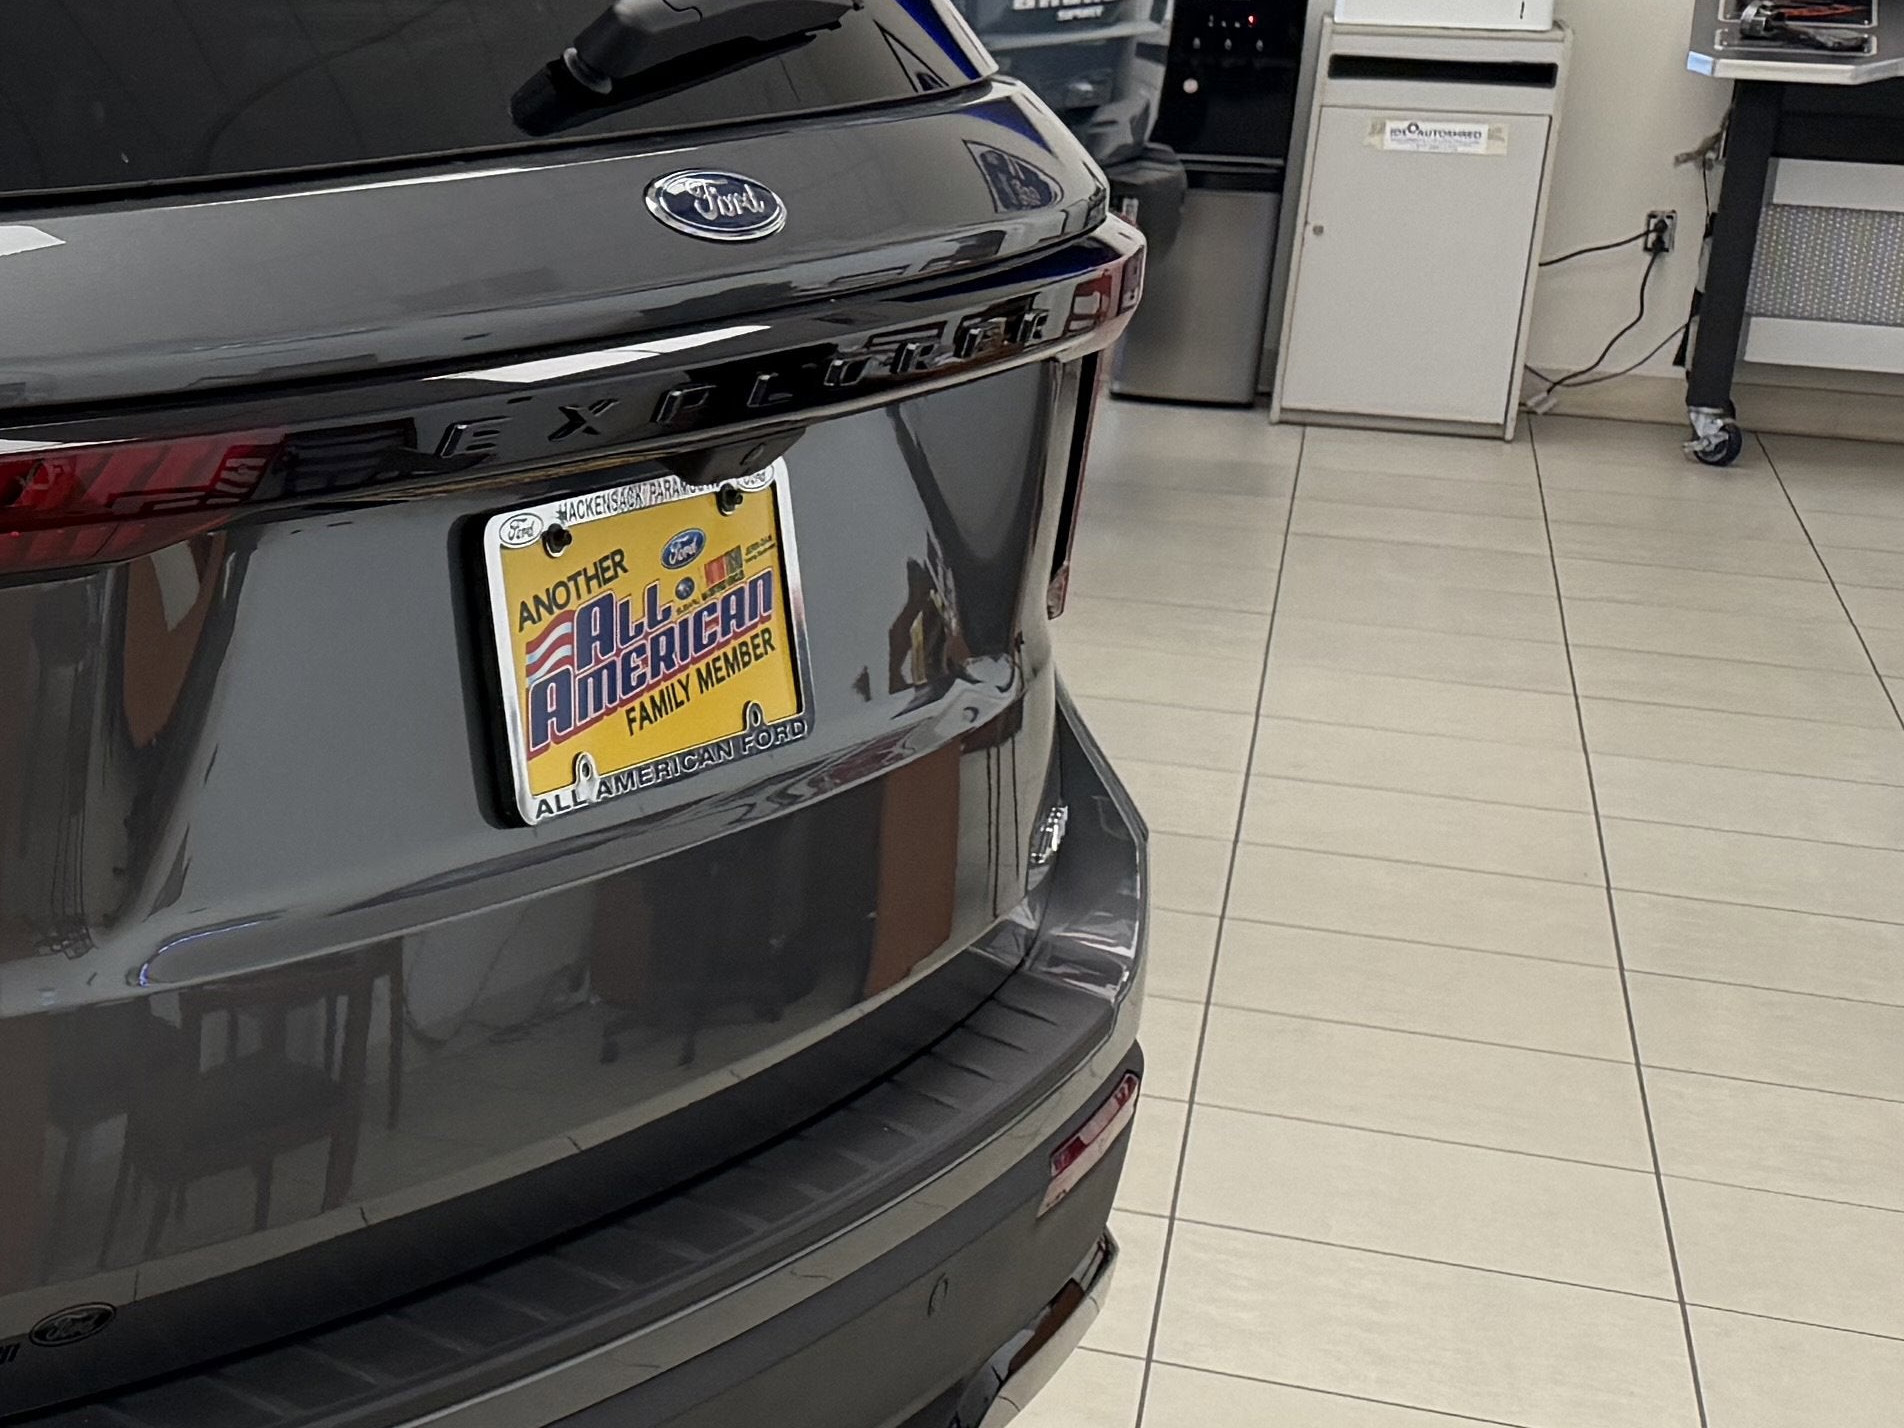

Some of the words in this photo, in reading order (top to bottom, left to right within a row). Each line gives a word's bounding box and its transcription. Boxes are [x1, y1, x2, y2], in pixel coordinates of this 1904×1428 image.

[690, 177, 766, 221] Ford
[434, 308, 1050, 458] EXPLORER
[507, 516, 534, 541] Ford
[559, 482, 644, 523] HACKENSACK
[517, 548, 629, 633] ANOTHER
[574, 579, 675, 675] ALL
[527, 567, 776, 758] AMERICAN
[624, 673, 692, 737] FAMILY
[698, 626, 777, 695] MEMBER
[535, 787, 589, 820] ALL
[595, 739, 735, 801] AMERICAN
[741, 719, 809, 755] FORD
